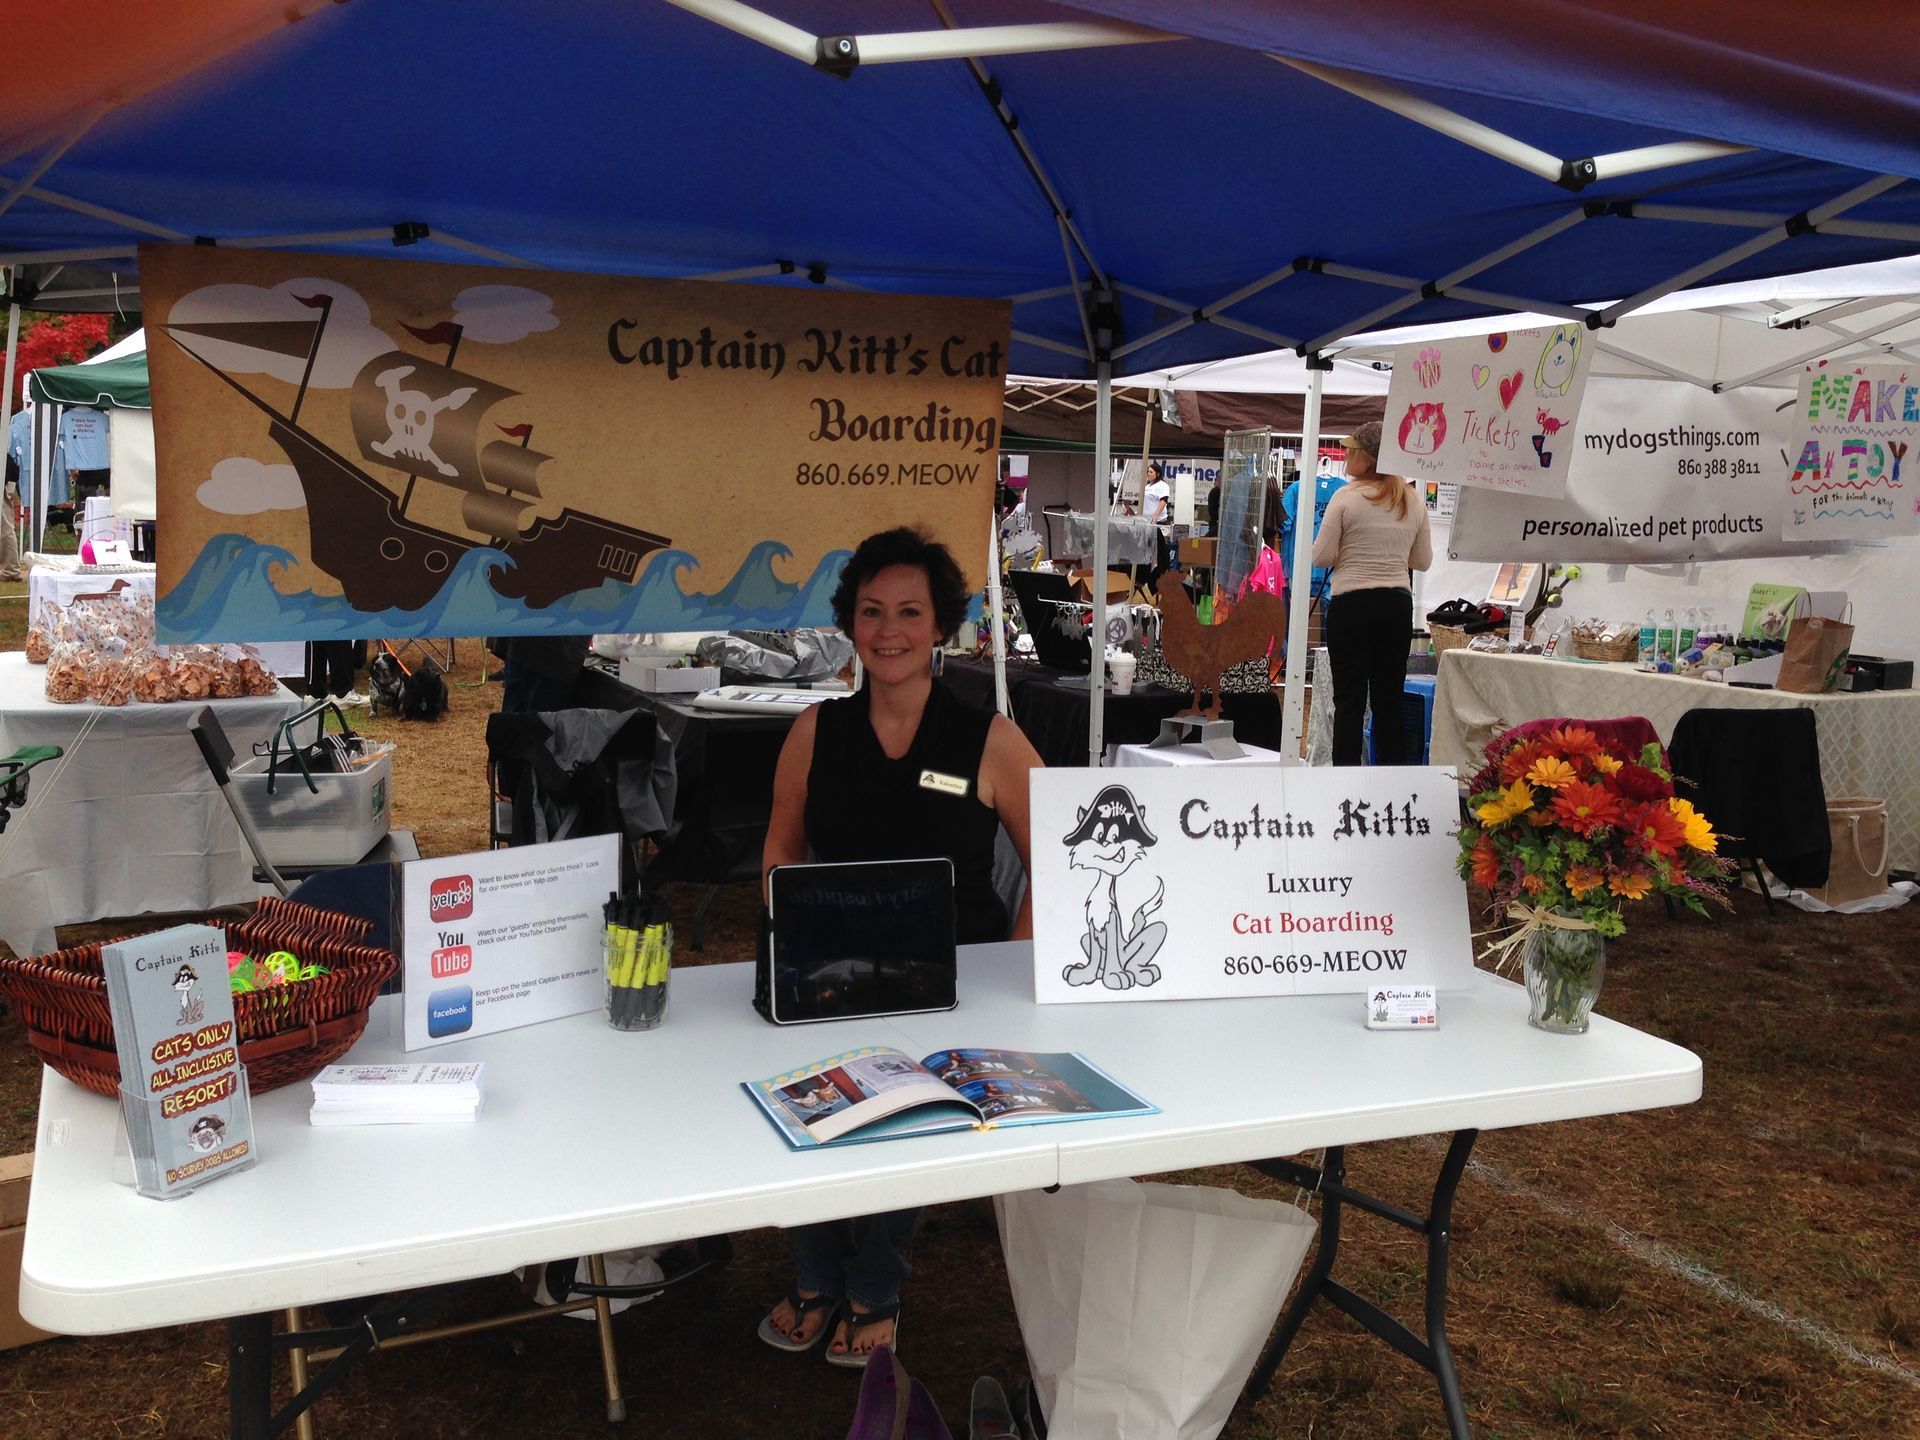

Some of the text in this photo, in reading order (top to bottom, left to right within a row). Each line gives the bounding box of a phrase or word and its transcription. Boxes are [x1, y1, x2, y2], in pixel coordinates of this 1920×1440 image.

[607, 318, 1006, 381] Captain Kitt's Cat
[1808, 374, 1920, 422] MAKE
[809, 398, 997, 455] Boarding
[1584, 425, 1760, 454] mydogsthings.com
[1678, 458, 1760, 478] 860 388 3811
[1791, 439, 1908, 482] A TOY
[796, 463, 980, 487] 860.669.MEOW
[1522, 513, 1763, 542] personalized pet products
[1179, 794, 1431, 850] Captain Kitt's
[478, 876, 495, 885] Want
[503, 873, 519, 881] know
[520, 870, 536, 878] what
[1268, 872, 1353, 898] Luxury
[432, 890, 459, 911] yelp
[477, 927, 497, 938] Watch
[532, 918, 556, 928] enjoying
[1233, 910, 1394, 937] Cat Boarding
[438, 931, 464, 949] You
[477, 937, 495, 946] check
[495, 935, 507, 943] out
[135, 954, 183, 971] Captain
[434, 952, 469, 974] Tube
[1223, 949, 1407, 977] 860-669-MEOW
[475, 989, 492, 998] Keep
[492, 987, 501, 995] up
[501, 985, 509, 993] on
[510, 982, 520, 990] the
[521, 979, 538, 988] latest
[538, 975, 561, 985] Captain
[487, 992, 515, 1003] Facebook
[515, 989, 531, 999] page
[433, 1005, 468, 1019] facebook
[154, 1024, 230, 1060] CATS ONLY
[152, 1050, 235, 1089] ALL INCLUSIVE
[163, 1075, 233, 1115] RESORT!
